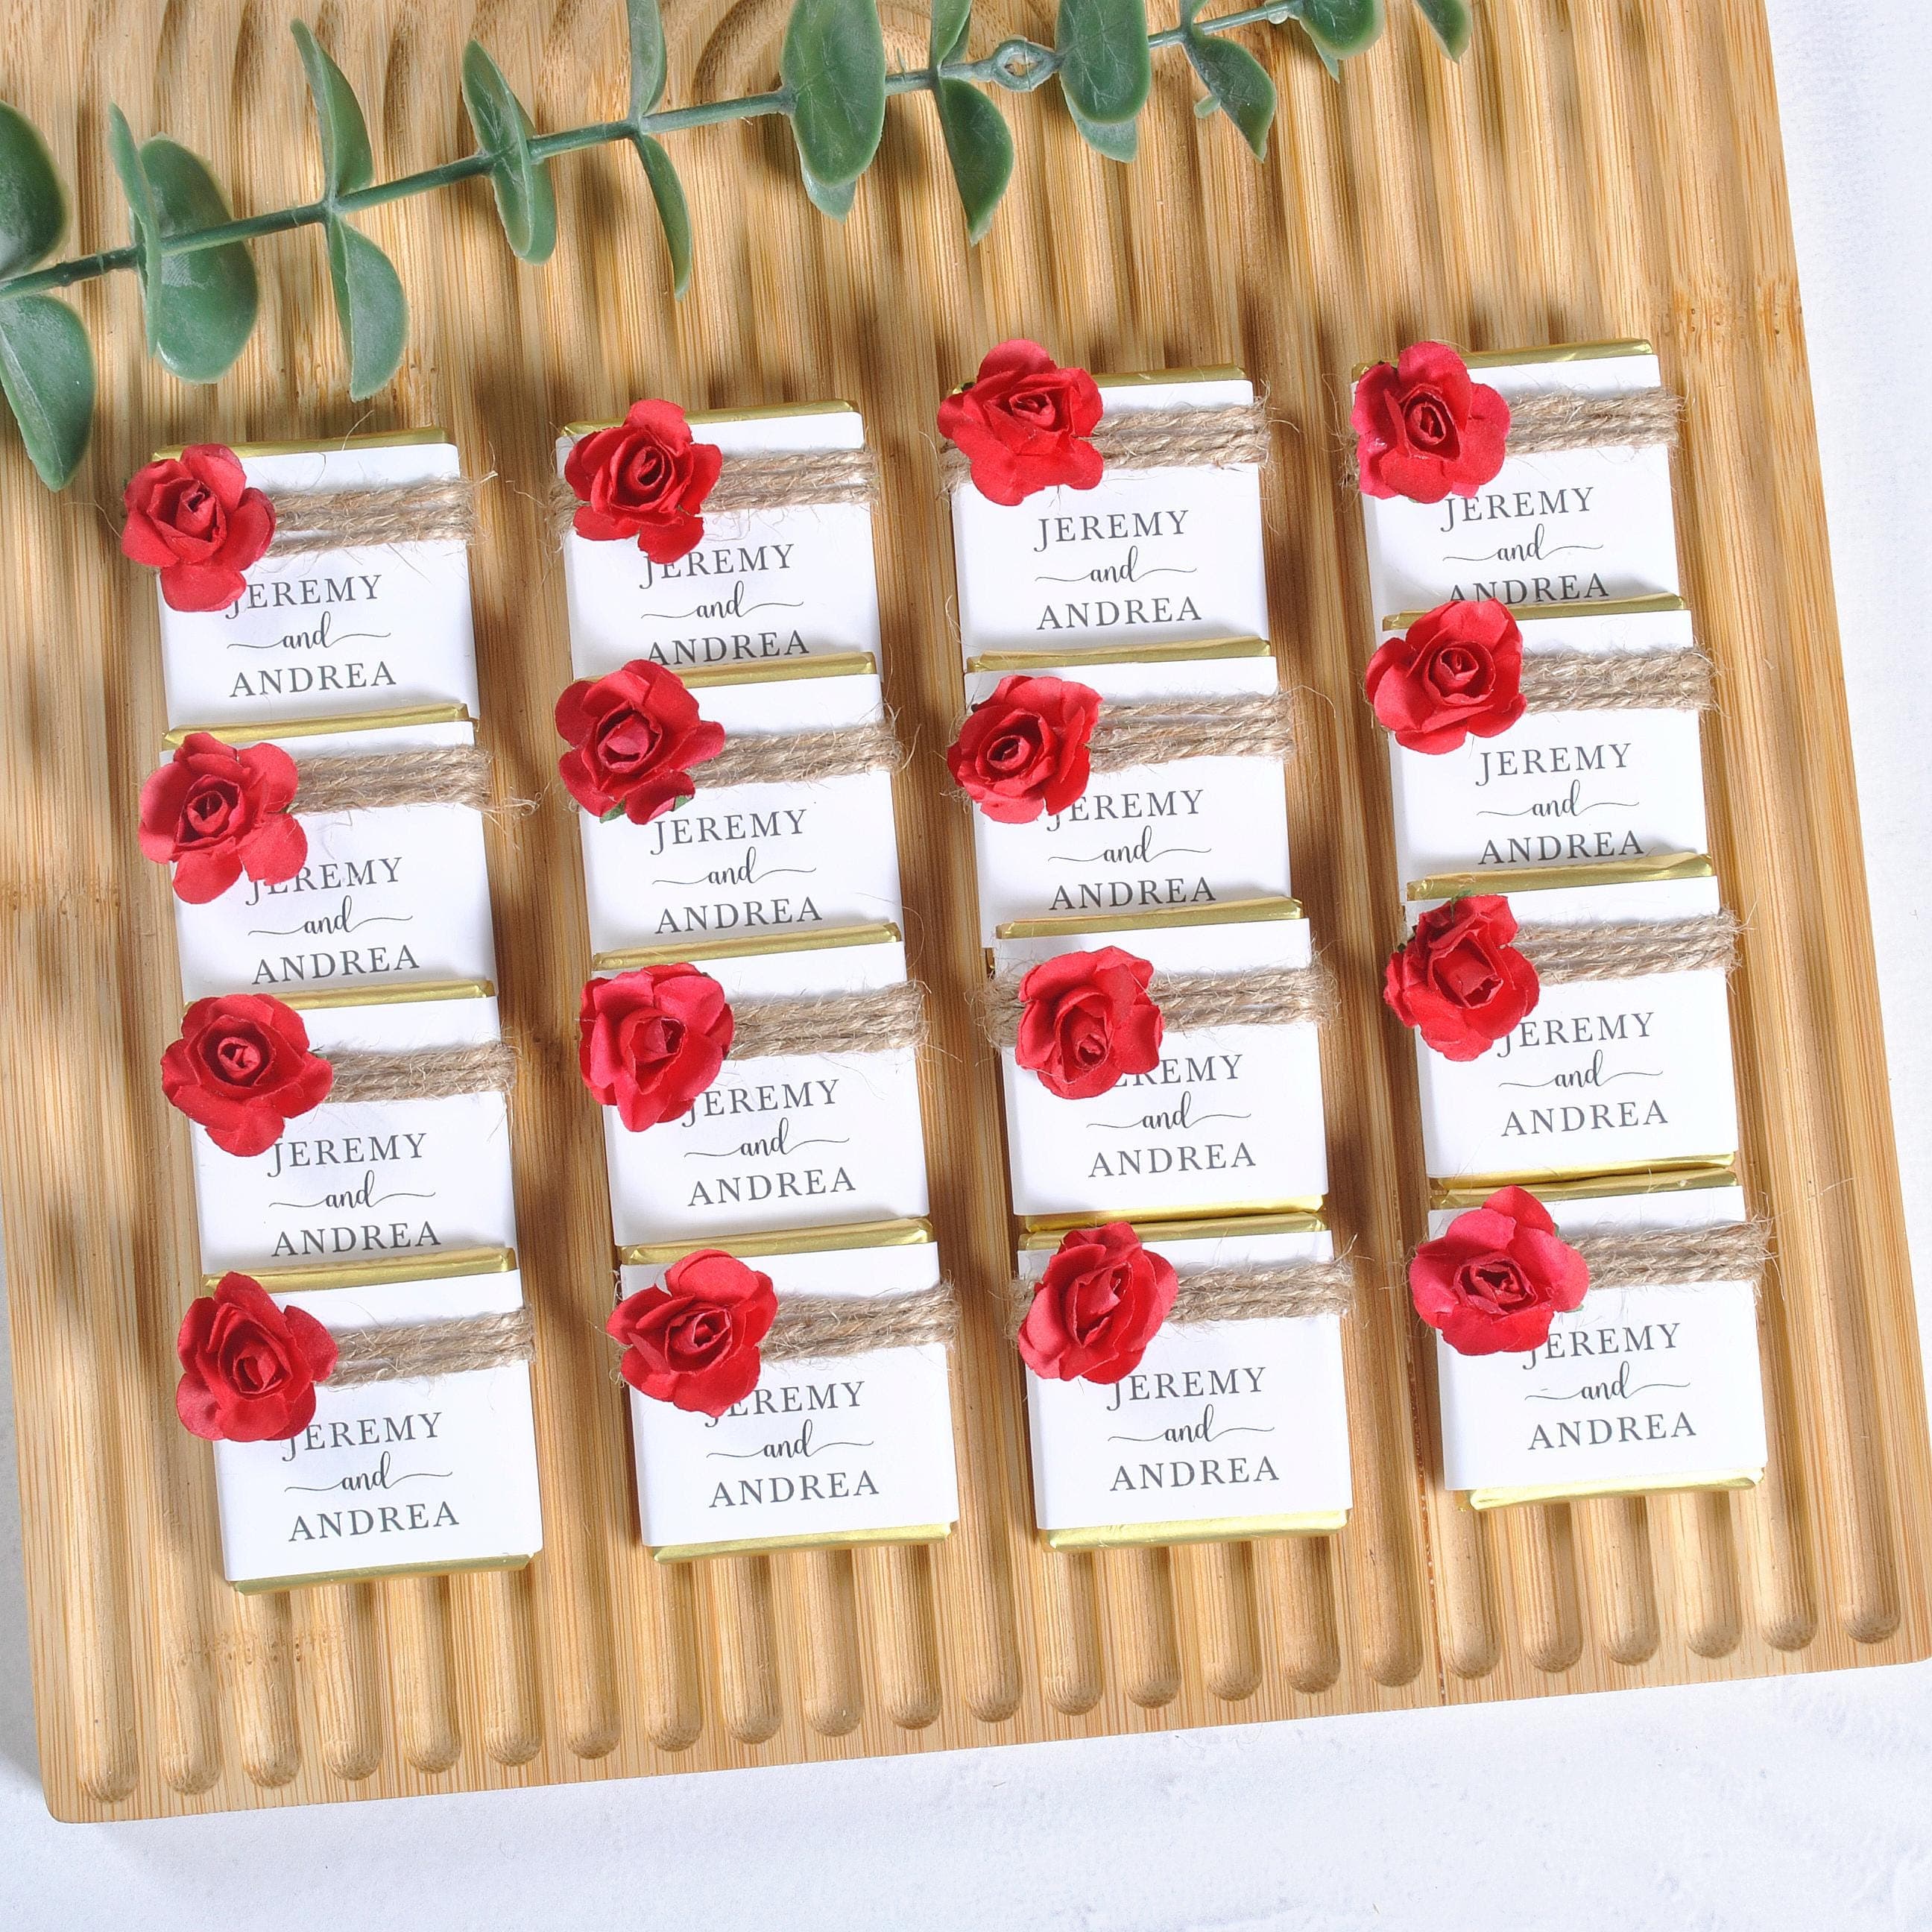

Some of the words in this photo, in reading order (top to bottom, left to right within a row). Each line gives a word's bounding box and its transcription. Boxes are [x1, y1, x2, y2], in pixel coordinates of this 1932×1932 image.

[1439, 486, 1594, 532] JEREMY
[1033, 510, 1189, 552] JEREMY
[1449, 572, 1610, 605] ANDREA
[1036, 596, 1202, 631] ANDREA
[648, 629, 810, 666] ANDREA
[229, 660, 397, 698] ANDREA
[1475, 742, 1632, 786] JEREMY
[649, 808, 808, 856] JEREMY
[1478, 830, 1644, 865] ANDREA
[1049, 876, 1216, 911] ANDREA
[654, 896, 823, 934] ANDREA
[251, 944, 420, 985] ANDREA
[1500, 1099, 1668, 1137] ANDREA
[266, 1132, 427, 1178] JEREMY
[1087, 1141, 1257, 1178] ANDREA
[687, 1166, 856, 1207] ANDREA
[271, 1220, 442, 1257] ANDREA
[1106, 1366, 1267, 1411] JEREMY
[1527, 1411, 1697, 1450] ANDREA
[708, 1469, 880, 1509] ANDREA
[1110, 1455, 1279, 1491] ANDREA
[288, 1500, 459, 1541] ANDREA
